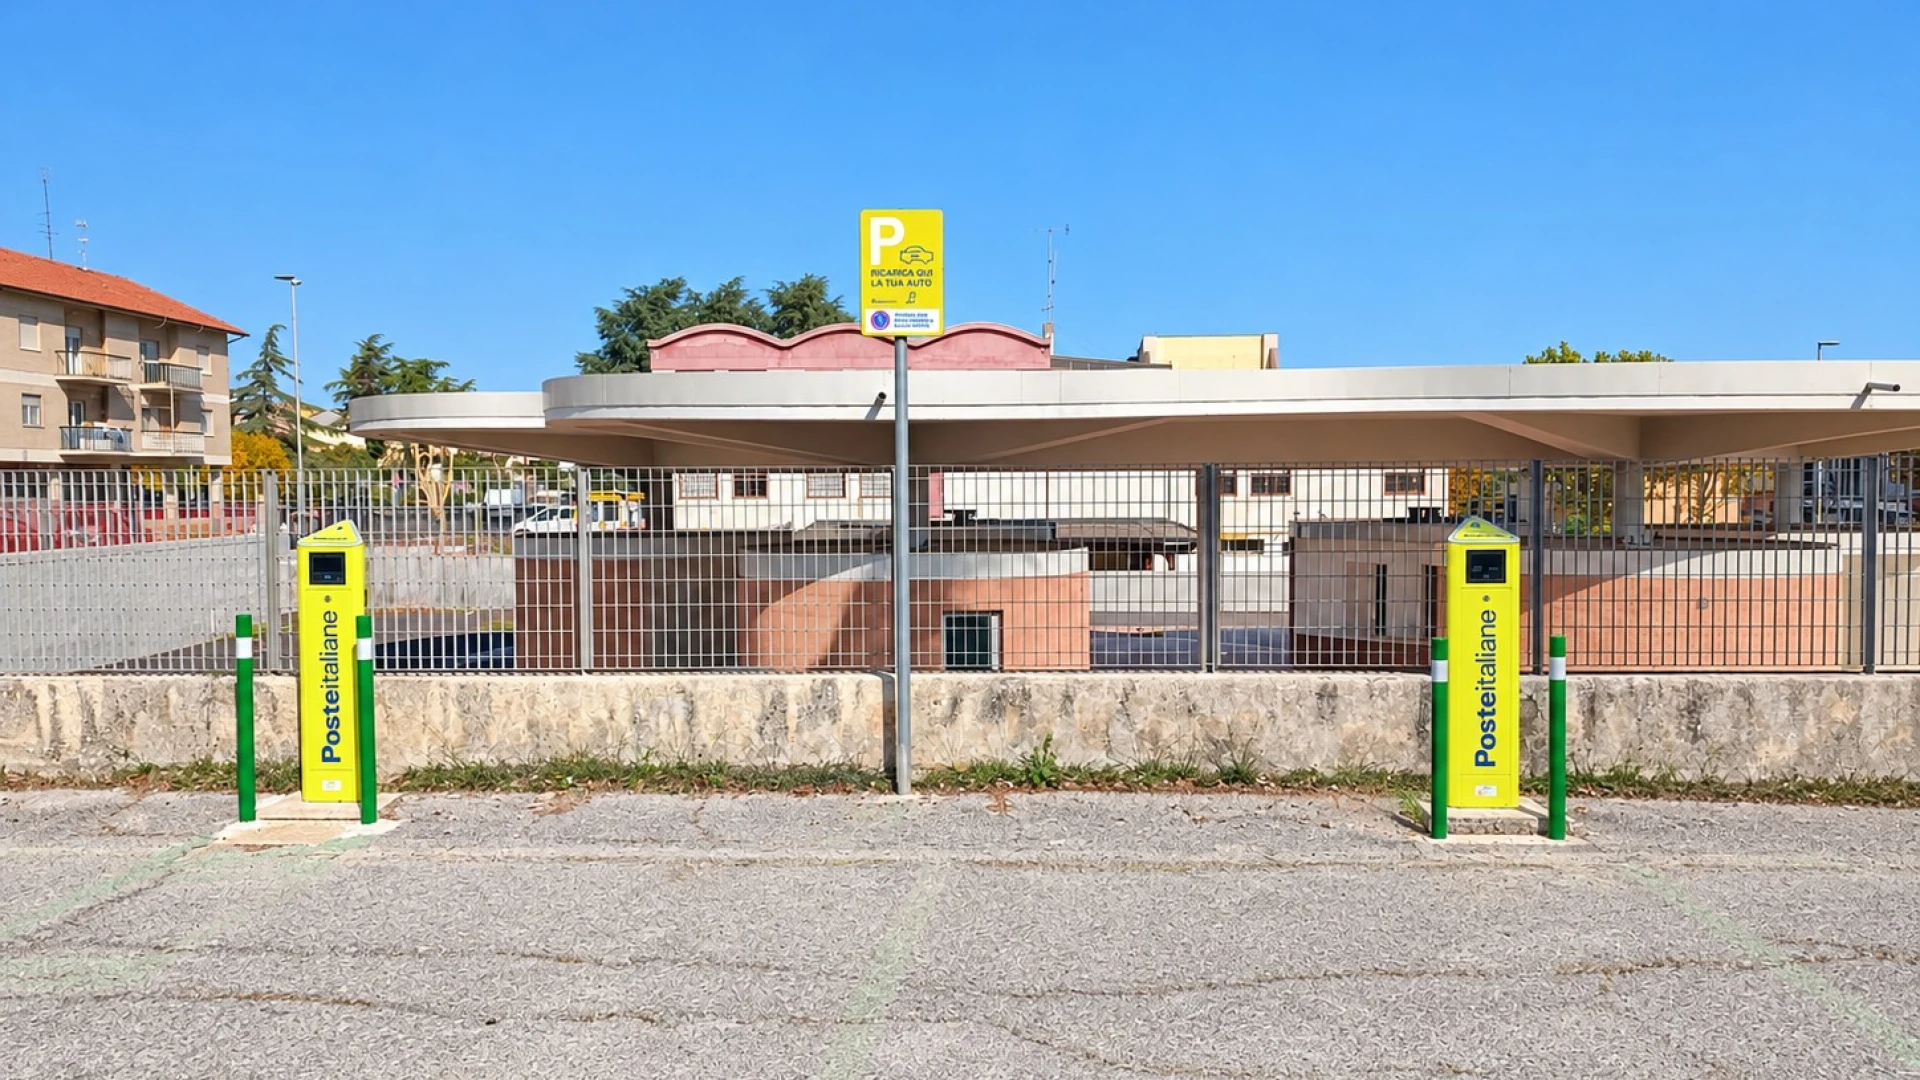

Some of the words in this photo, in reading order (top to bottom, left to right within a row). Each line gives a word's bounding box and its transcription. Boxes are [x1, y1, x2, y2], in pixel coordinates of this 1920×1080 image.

[870, 216, 904, 265] P
[870, 269, 914, 277] RICARICA
[870, 279, 883, 287] LA
[886, 279, 904, 287] TUA
[907, 279, 932, 287] AUTO
[319, 610, 341, 763] Posteitaliane
[1475, 609, 1496, 767] Posteitaliane
